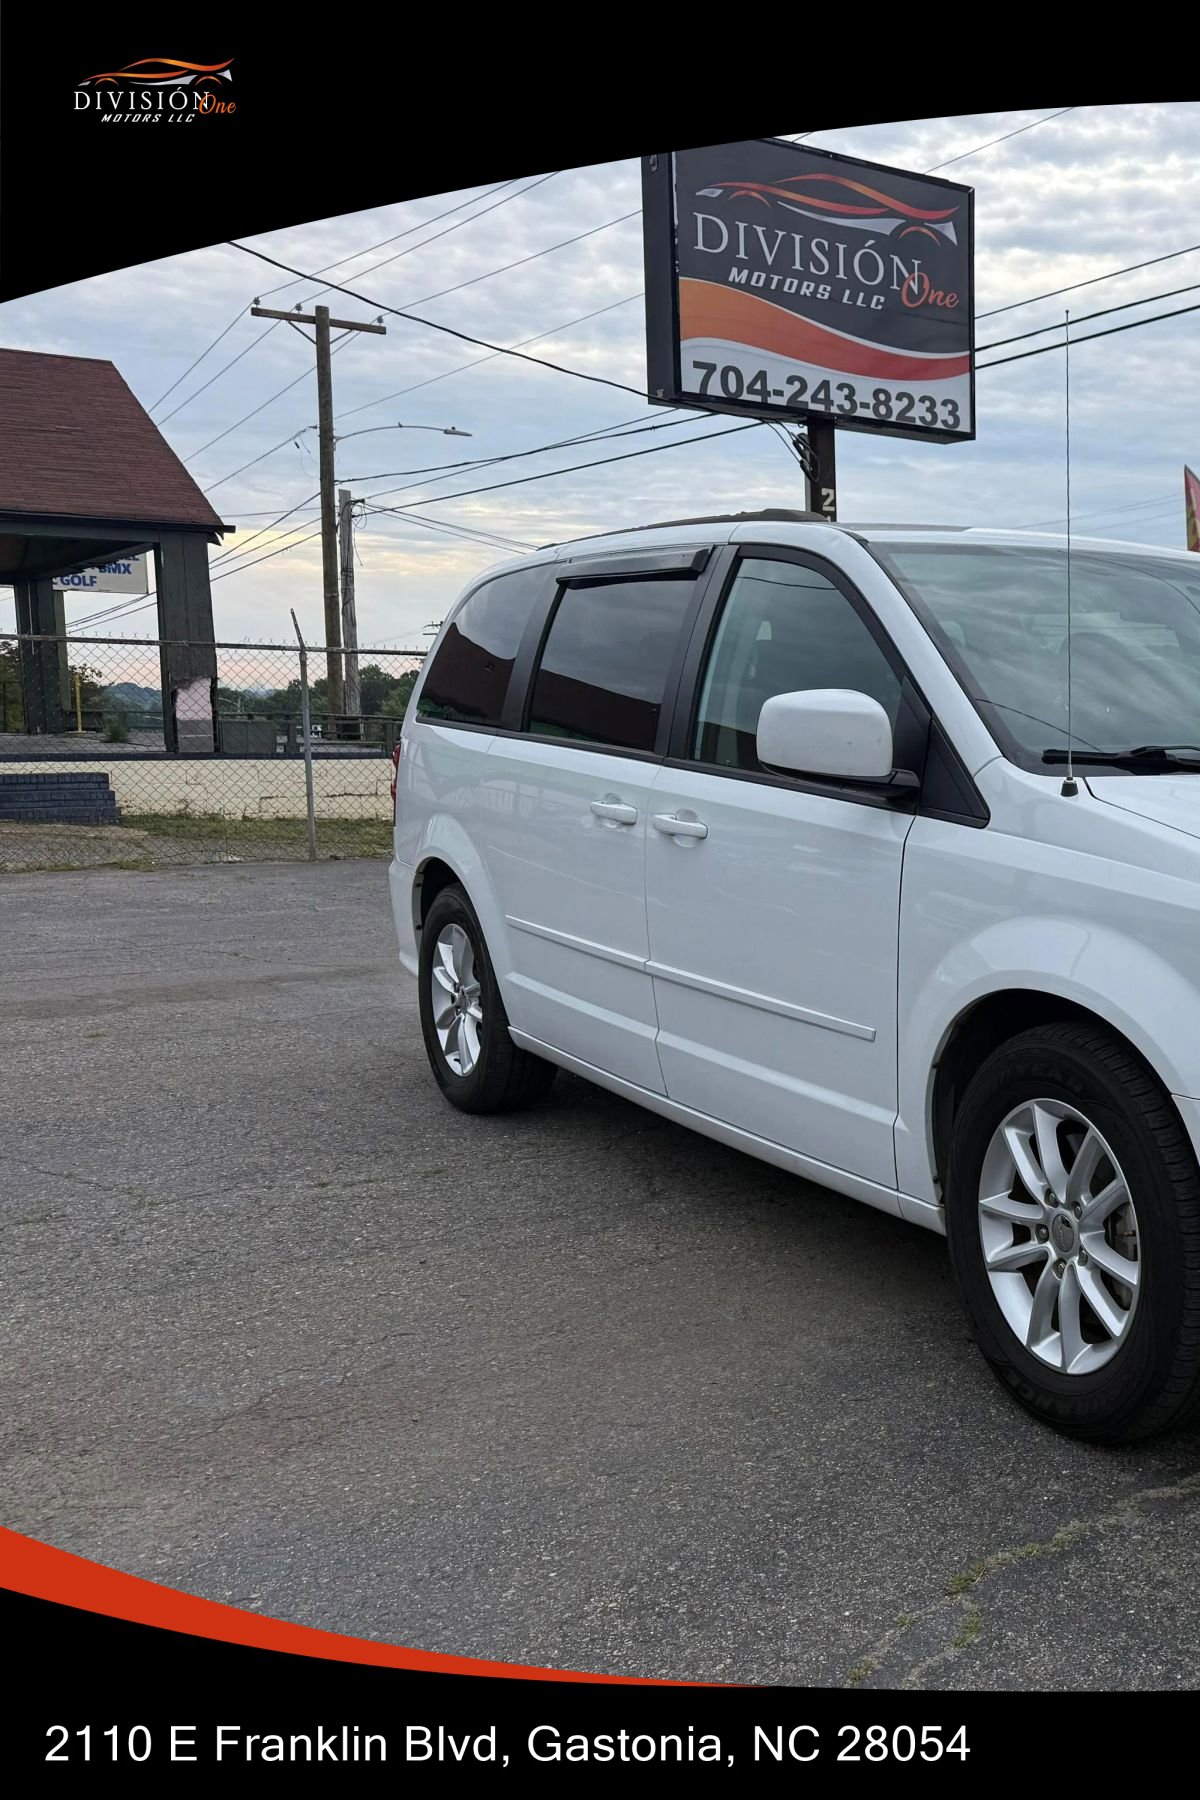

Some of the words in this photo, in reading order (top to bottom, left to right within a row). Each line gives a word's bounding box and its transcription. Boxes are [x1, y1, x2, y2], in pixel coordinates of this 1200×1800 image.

[692, 211, 922, 295] DIVISIÓN
[901, 271, 960, 309] One
[728, 266, 832, 301] MOTORS
[841, 288, 886, 311] LLC
[692, 360, 961, 431] 704-243-8233
[60, 575, 97, 587] GOLF
